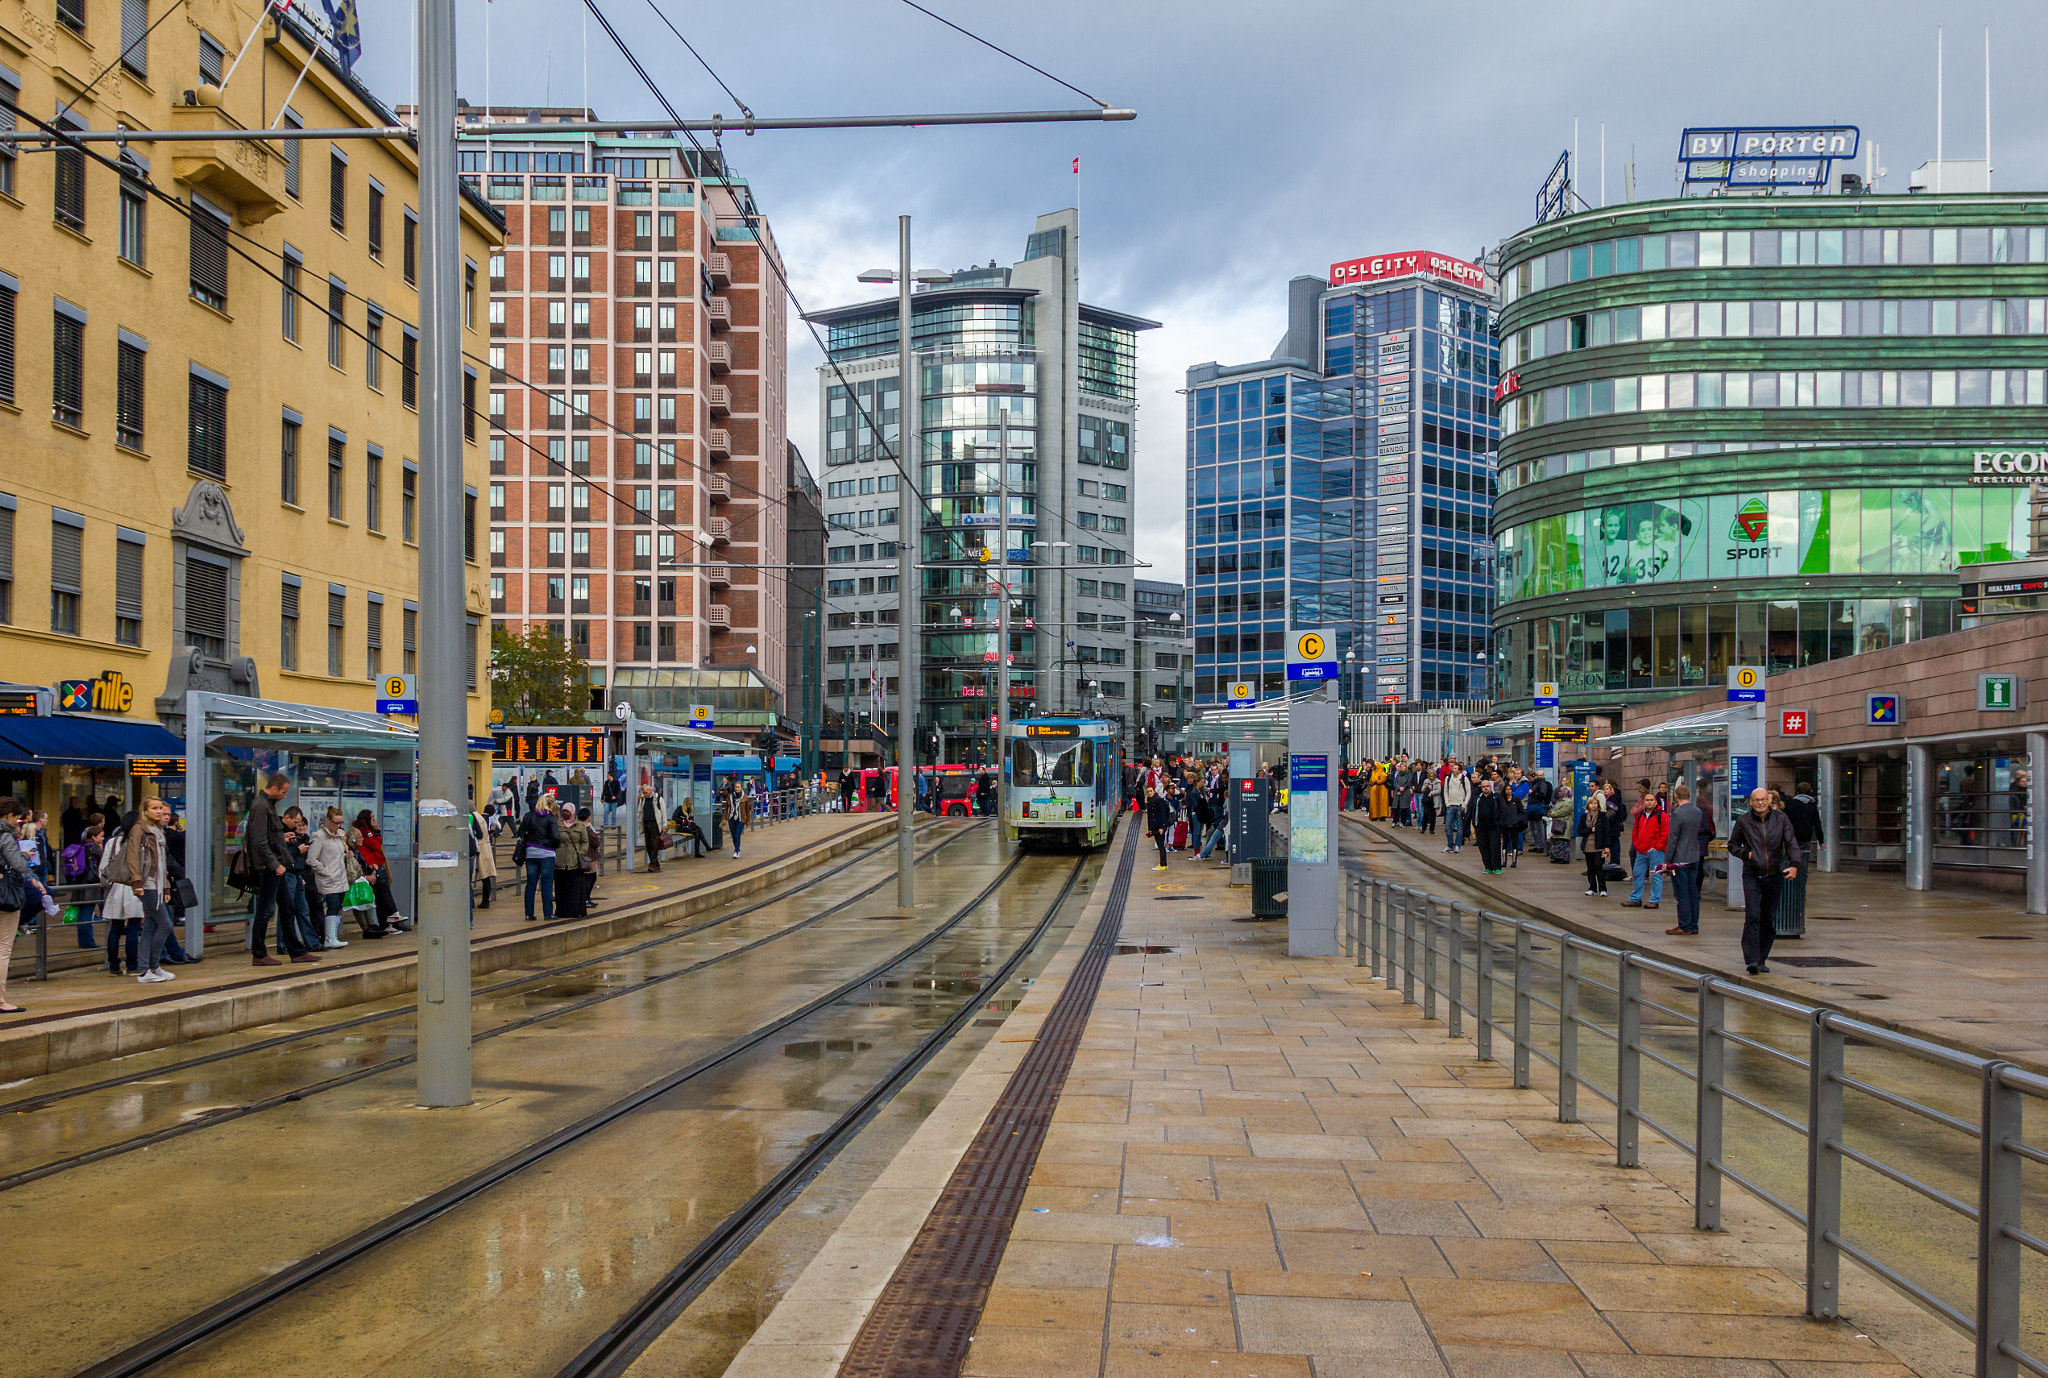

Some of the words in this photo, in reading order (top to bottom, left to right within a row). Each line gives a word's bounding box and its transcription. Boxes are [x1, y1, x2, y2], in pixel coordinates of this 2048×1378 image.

[1692, 136, 1723, 155] BY
[1738, 164, 1817, 179] shopping
[1380, 475, 1405, 484] LINDEX
[1726, 546, 1782, 560] SPORT
[2003, 583, 2022, 592] TASTE
[2023, 581, 2044, 590] zero
[1305, 638, 1318, 655] C
[1743, 672, 1752, 684] D
[91, 671, 133, 712] nille
[391, 680, 401, 694] B
[1237, 685, 1245, 696] C
[1543, 686, 1551, 695] D
[698, 708, 705, 717] B
[1028, 726, 1035, 736] 11
